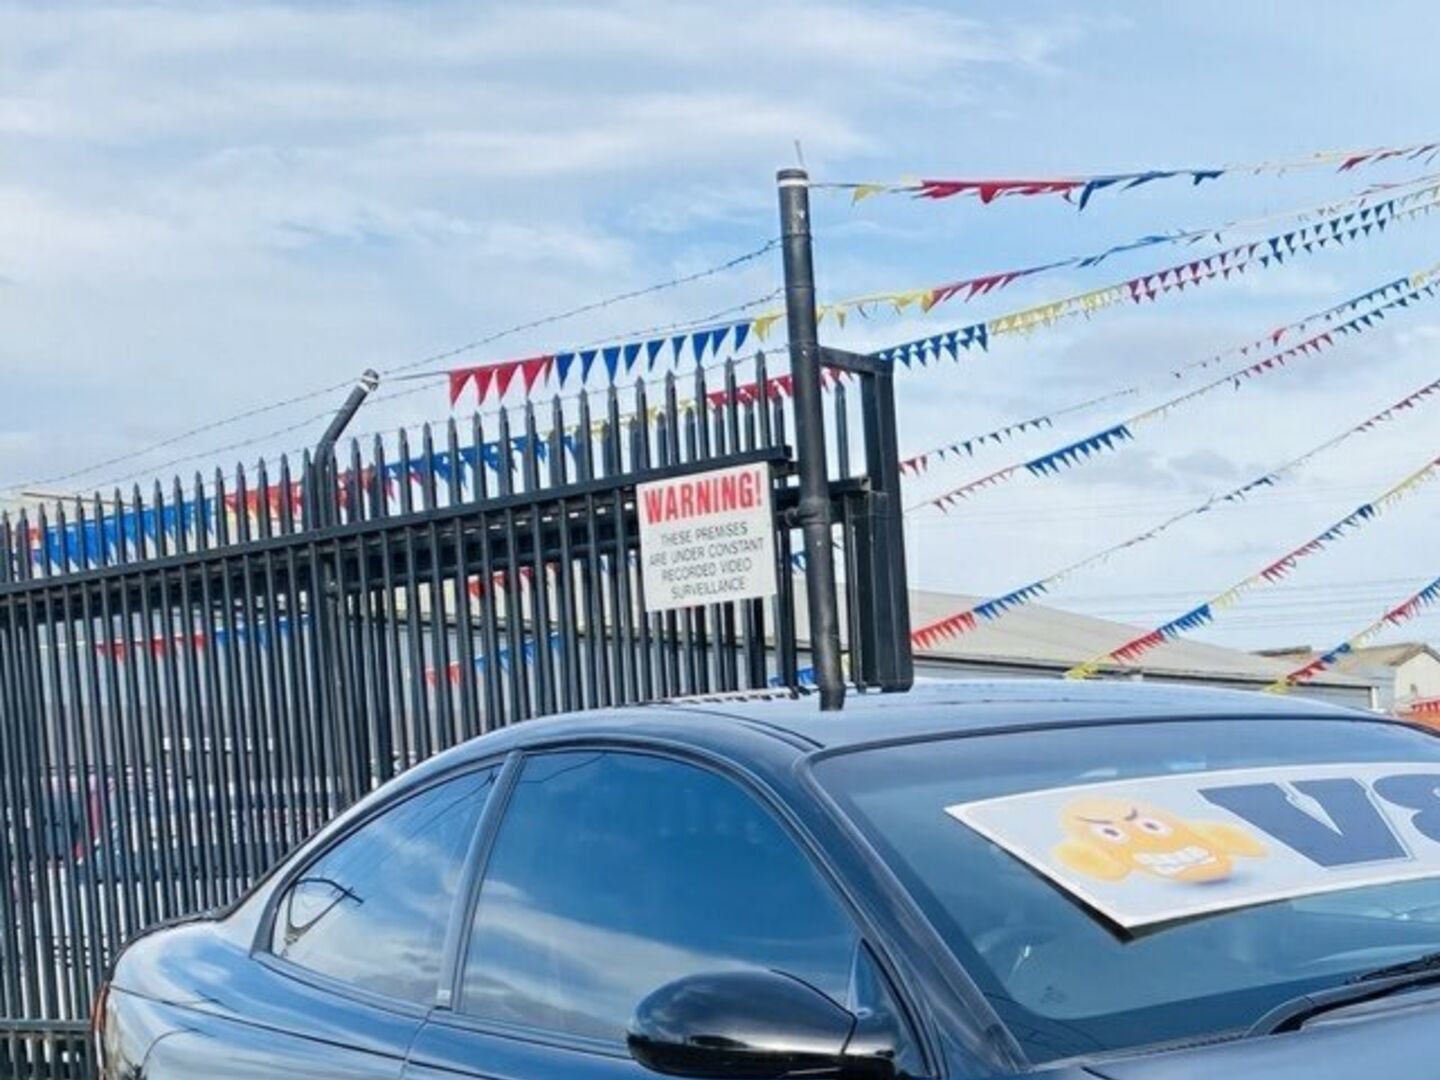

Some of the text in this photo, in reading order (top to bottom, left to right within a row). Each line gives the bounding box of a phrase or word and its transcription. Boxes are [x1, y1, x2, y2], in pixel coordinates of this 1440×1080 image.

[645, 472, 761, 524] WARNING!
[662, 522, 748, 545] THESE PREMISES
[650, 537, 763, 566] ARE UNDER CONSTANT
[661, 558, 751, 582] RECORDED VIDEO
[671, 578, 745, 599] SURVEILLANCE
